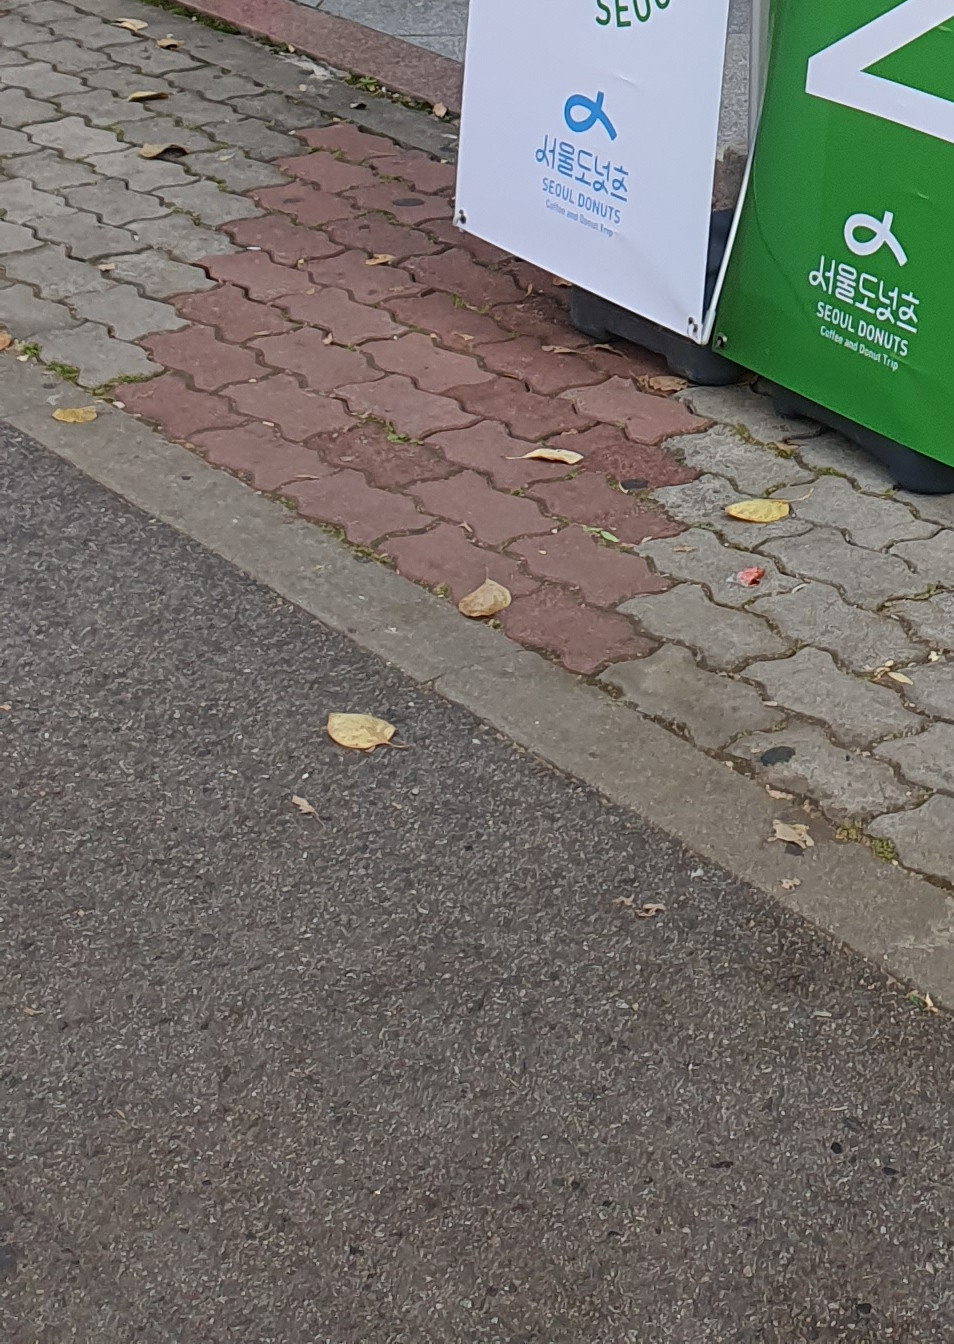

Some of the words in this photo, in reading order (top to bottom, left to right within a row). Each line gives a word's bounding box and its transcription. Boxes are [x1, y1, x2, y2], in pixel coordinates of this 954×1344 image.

[535, 134, 629, 203] 서울도넛츠
[542, 176, 574, 205] SEOUL
[577, 192, 621, 225] DONUTS
[808, 255, 920, 334] 서울도넛츠
[816, 301, 855, 333] SEOUL
[857, 319, 909, 357] DONUTS
[820, 325, 844, 345] Coffee
[844, 338, 858, 352] and
[882, 353, 899, 372] Trip
